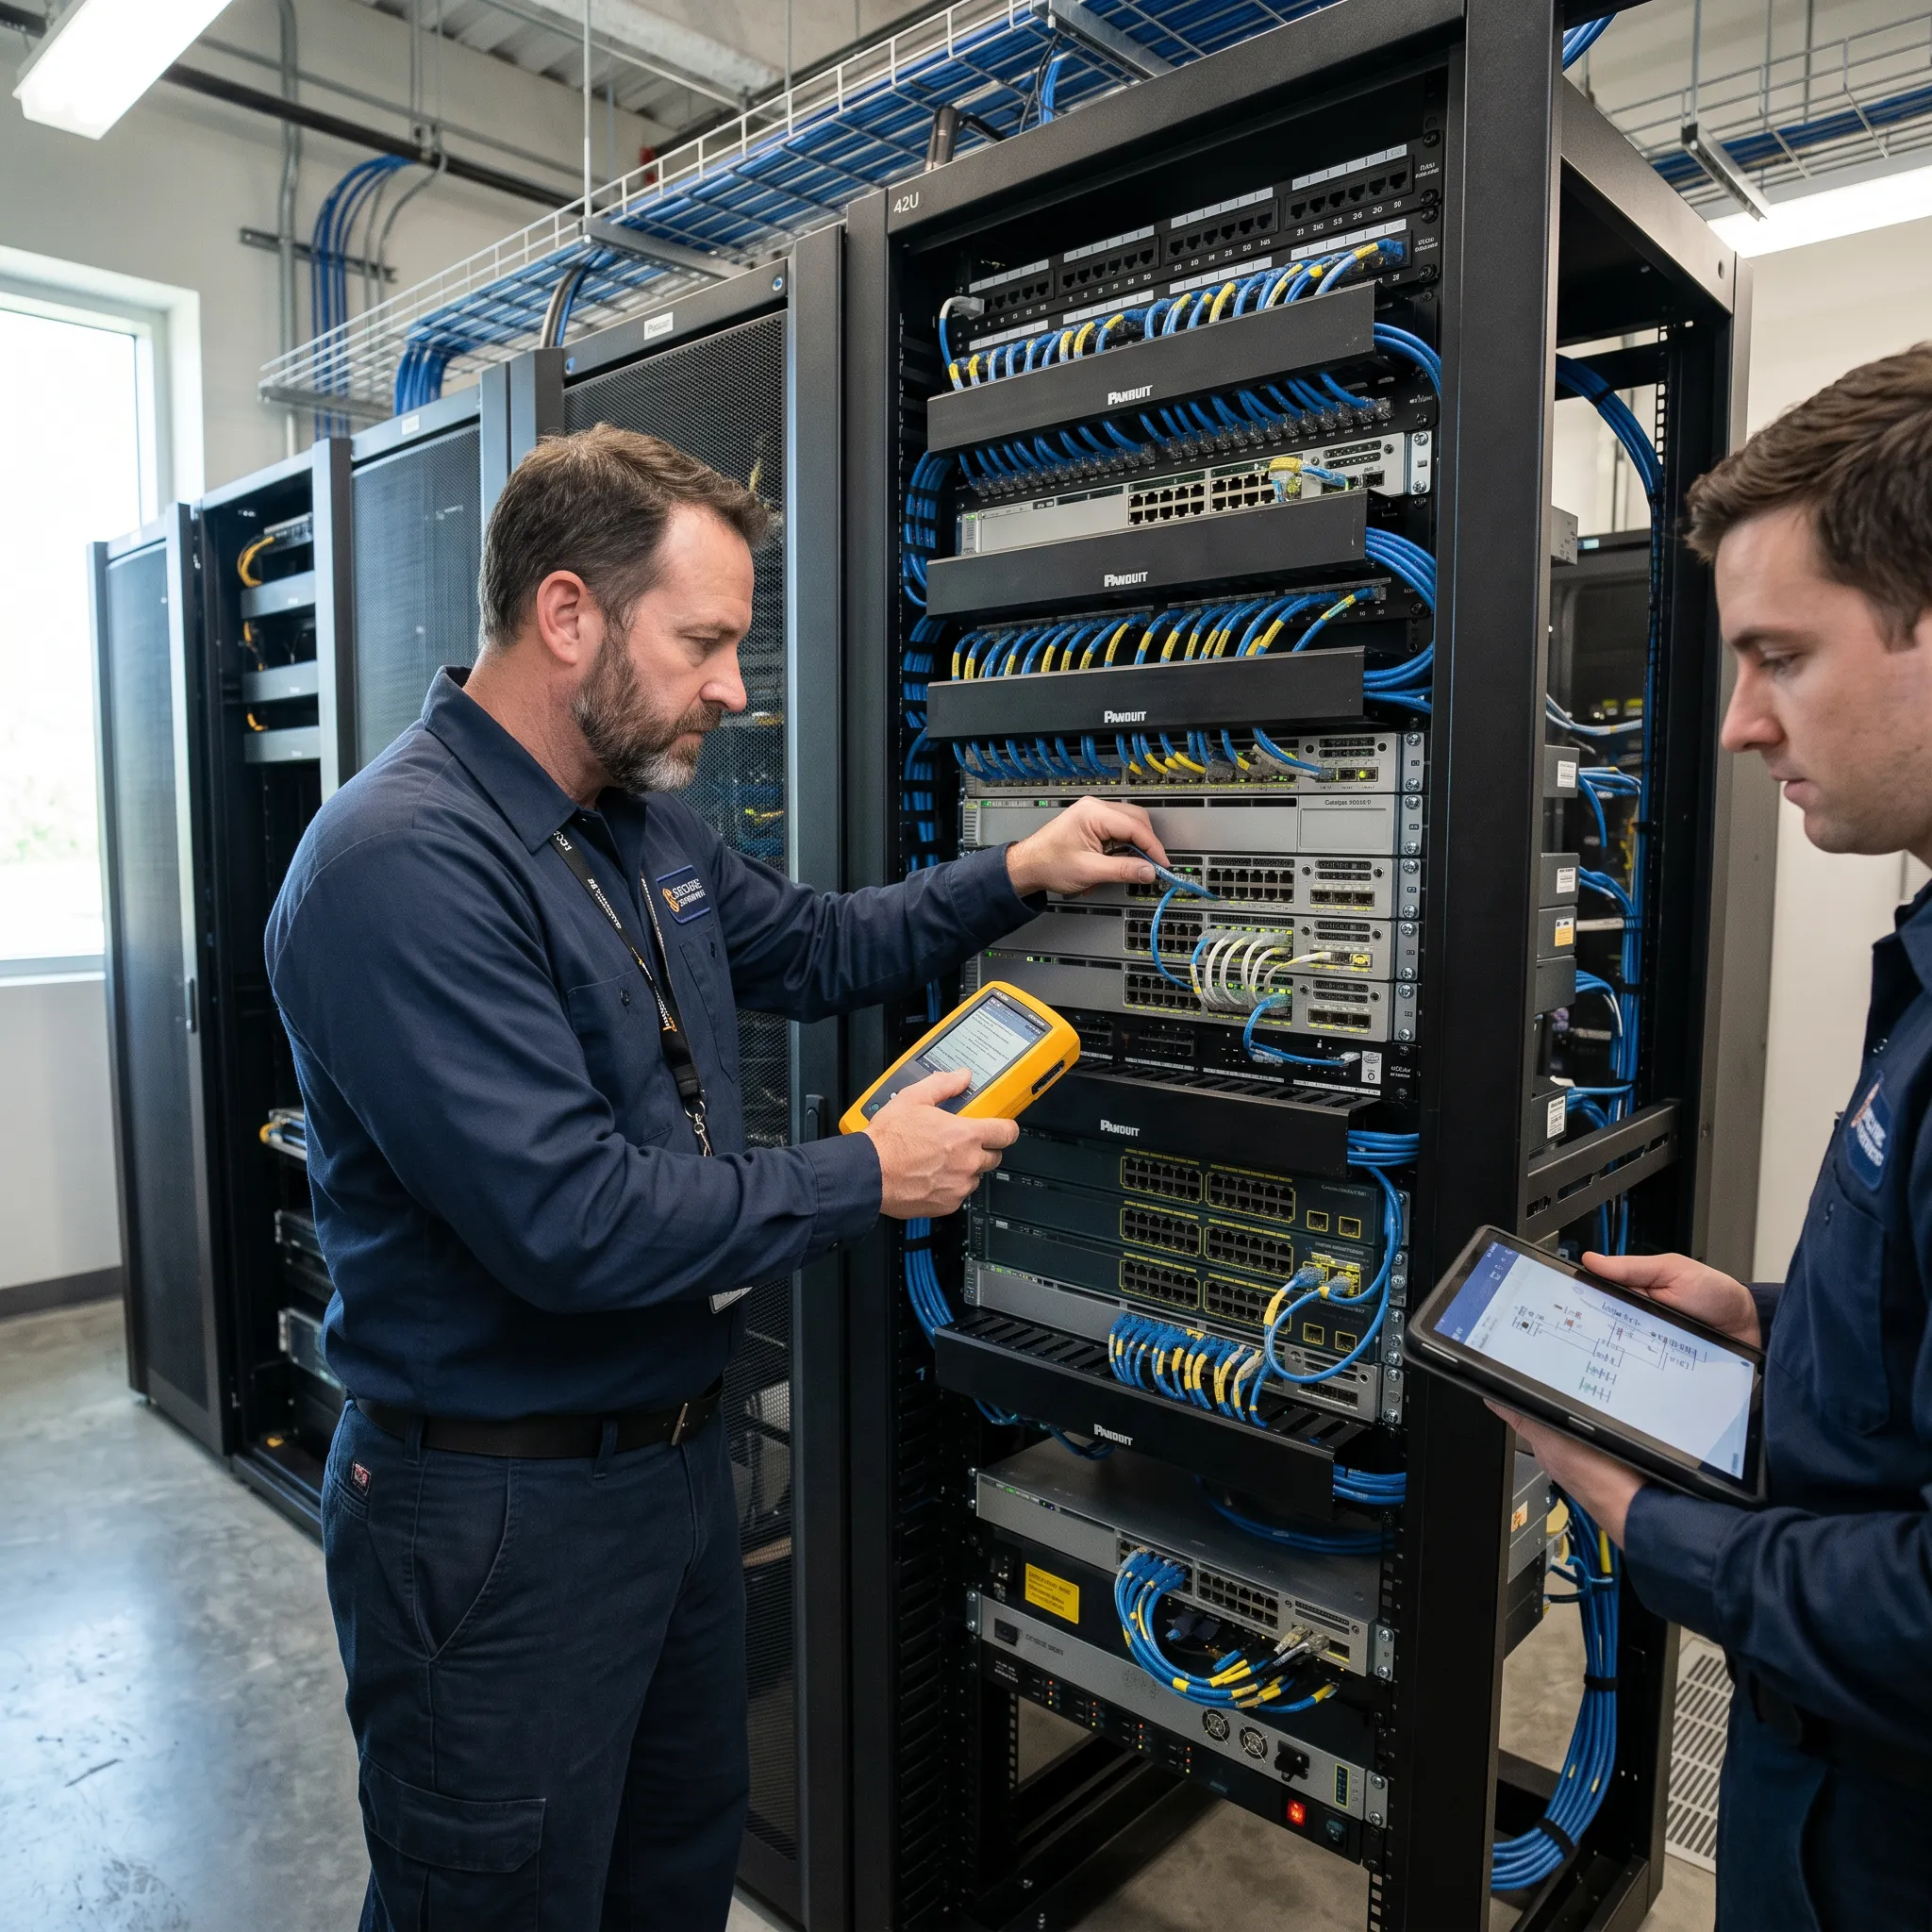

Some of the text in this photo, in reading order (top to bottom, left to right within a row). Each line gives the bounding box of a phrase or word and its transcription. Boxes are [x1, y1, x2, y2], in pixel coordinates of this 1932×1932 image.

[893, 192, 919, 213] 42U
[1104, 571, 1148, 588] PANDUIT
[1104, 710, 1147, 724] PANDUIT
[1100, 1119, 1141, 1137] PANDUIT
